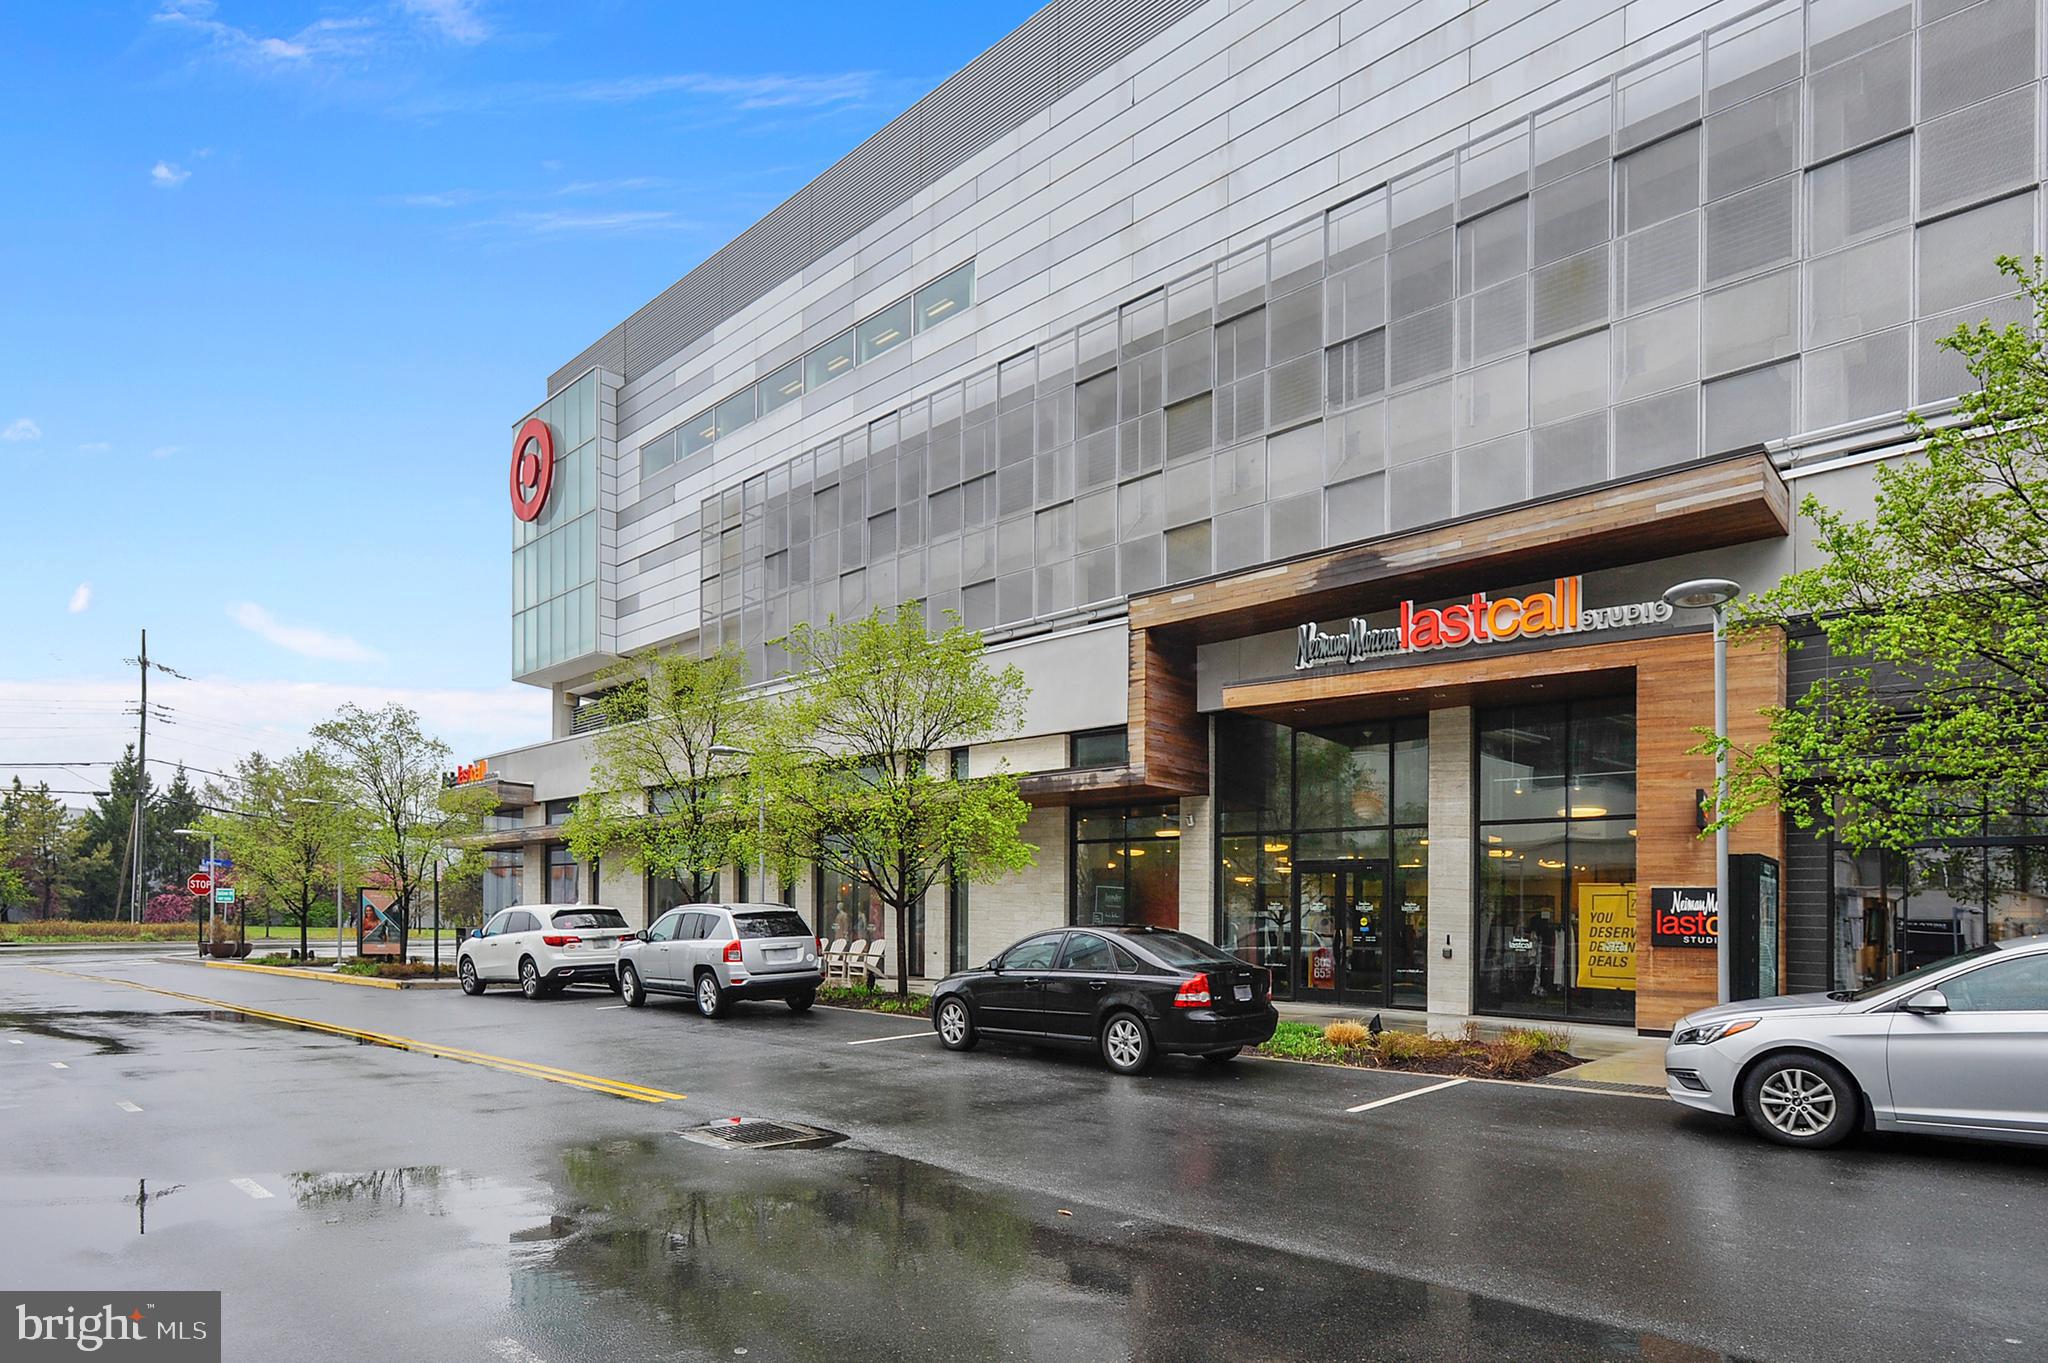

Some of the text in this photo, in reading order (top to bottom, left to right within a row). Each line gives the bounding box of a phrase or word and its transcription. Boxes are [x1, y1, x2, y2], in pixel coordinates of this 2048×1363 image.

[1296, 622, 1350, 669] Neiman
[1345, 618, 1401, 664] Marcus
[1582, 601, 1672, 631] STUDIO
[189, 880, 212, 889] STOP
[1670, 890, 1705, 914] Neiman
[1590, 911, 1613, 923] YOU
[1656, 909, 1718, 935] lastc
[1589, 926, 1637, 938] DESERV
[1683, 936, 1718, 944] STUDI
[1588, 955, 1628, 968] DEALS
